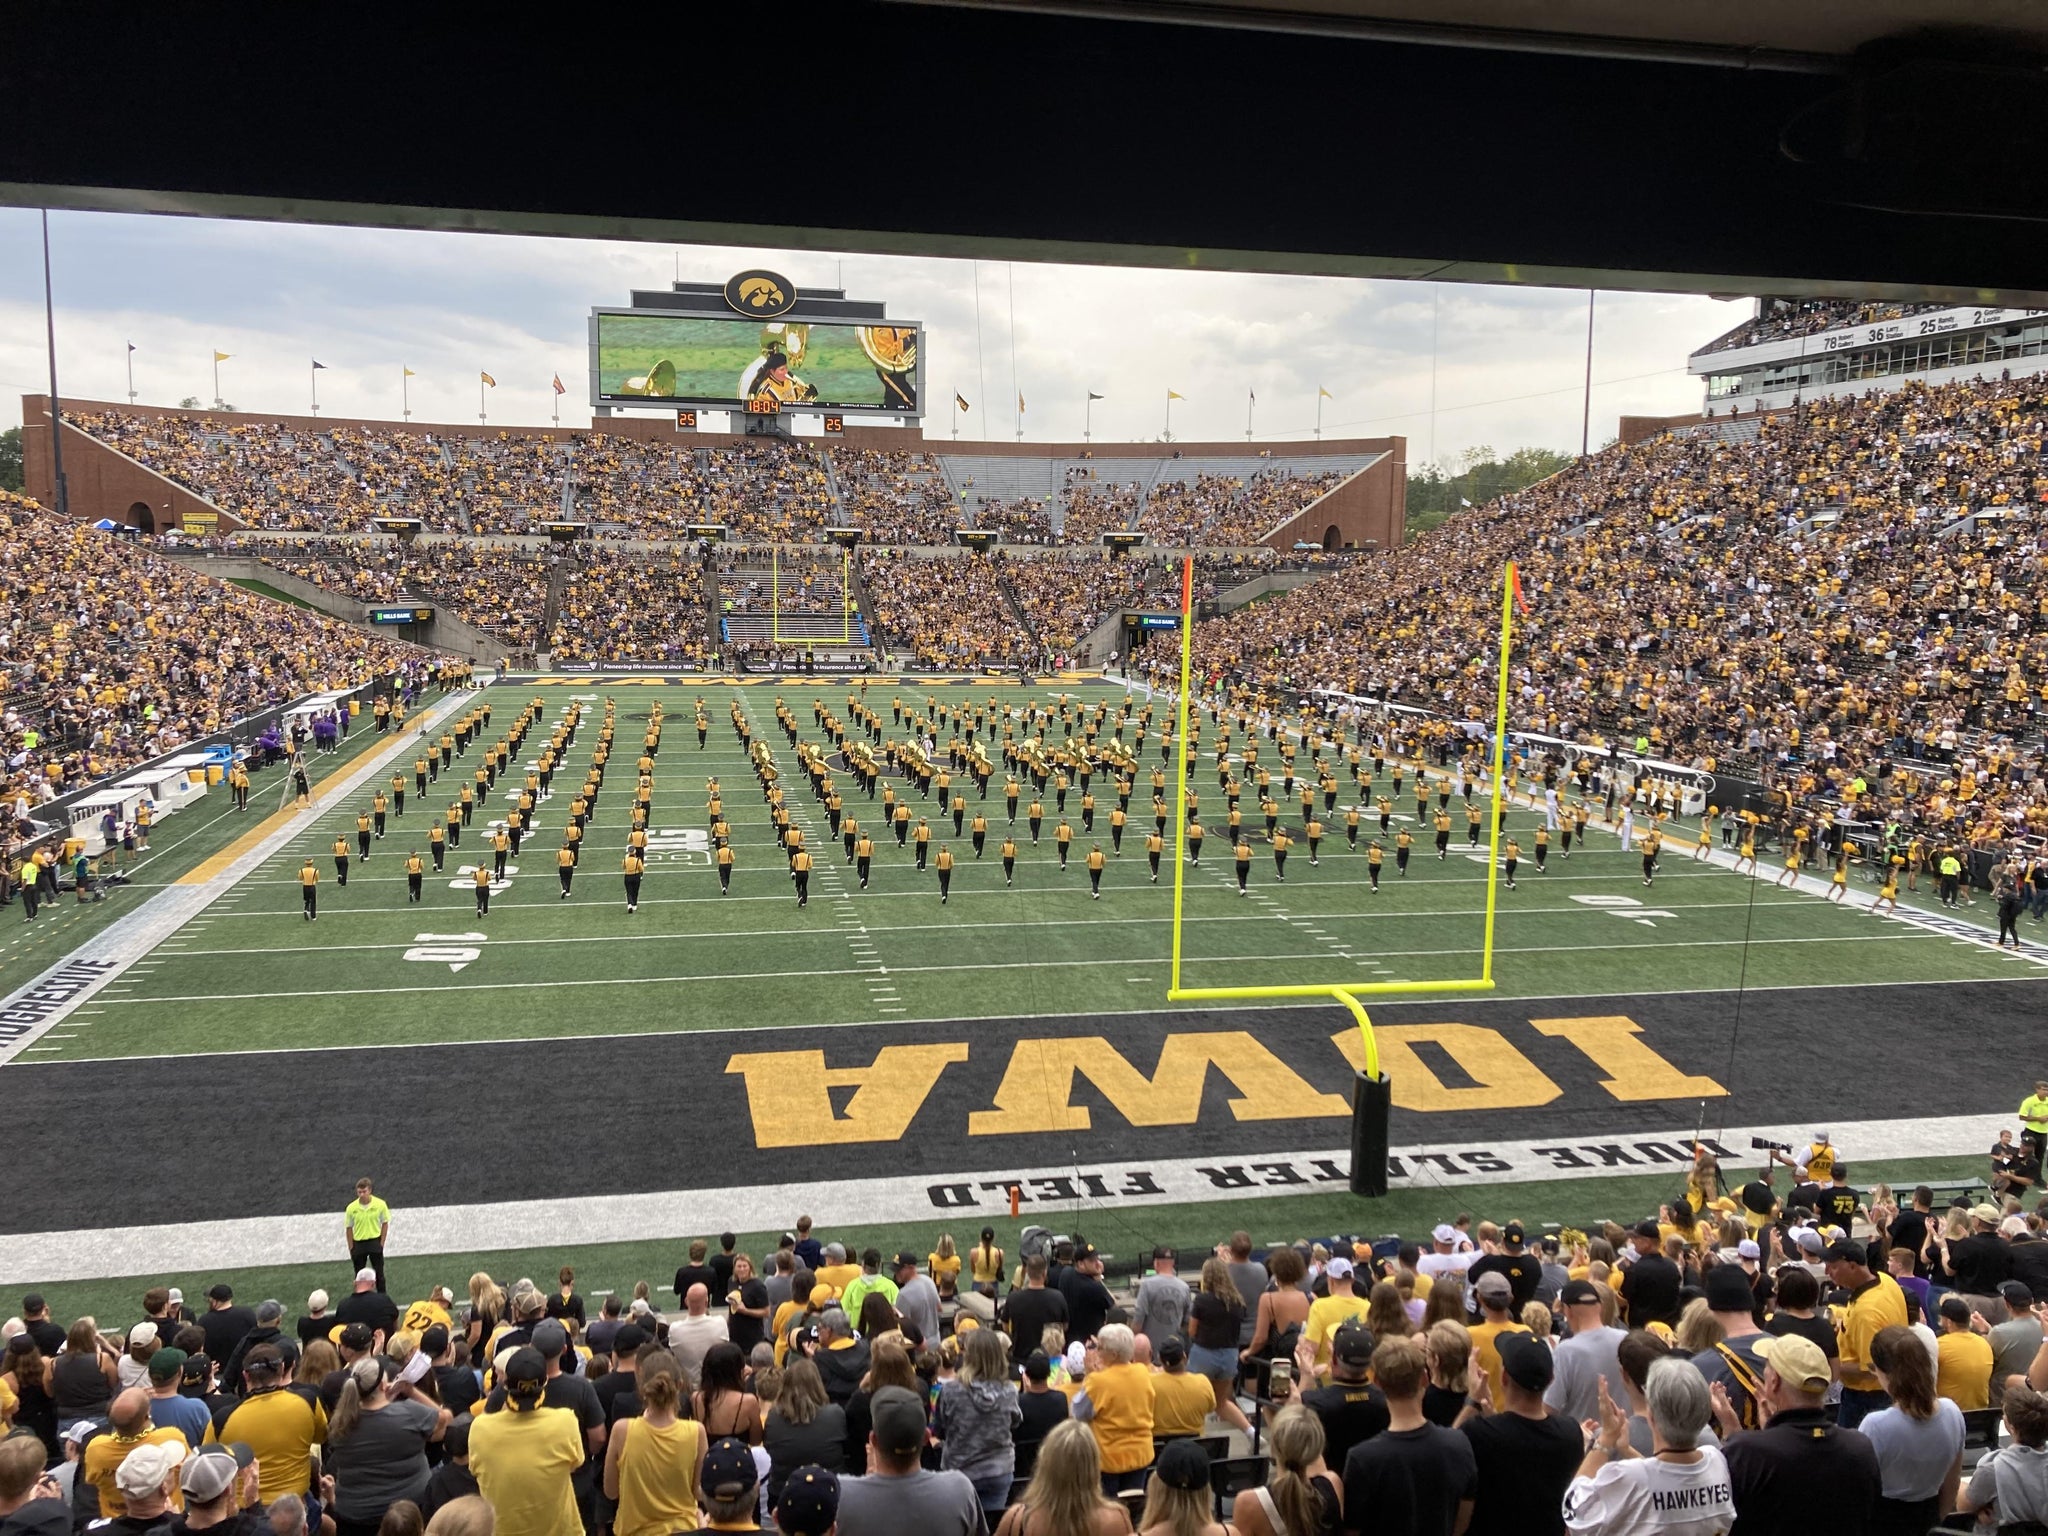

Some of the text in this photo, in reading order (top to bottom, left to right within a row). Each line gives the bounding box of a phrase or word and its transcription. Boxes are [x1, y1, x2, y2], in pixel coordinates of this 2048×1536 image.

[1974, 311, 1982, 325] 2
[1869, 323, 1884, 342] 36
[1920, 319, 1936, 334] 25
[1824, 336, 1838, 351] 78
[749, 400, 779, 412] 18:04
[679, 413, 695, 426] 25
[826, 418, 842, 431] 25
[603, 663, 632, 671] Pioneering
[724, 1014, 1732, 1149] IOWA
[1531, 1138, 1742, 1169] DUKE
[927, 1172, 1167, 1208] FIELD
[1833, 1200, 1855, 1214] 73
[406, 1311, 433, 1331] 22
[1653, 1483, 1729, 1511] HAWKEYES
